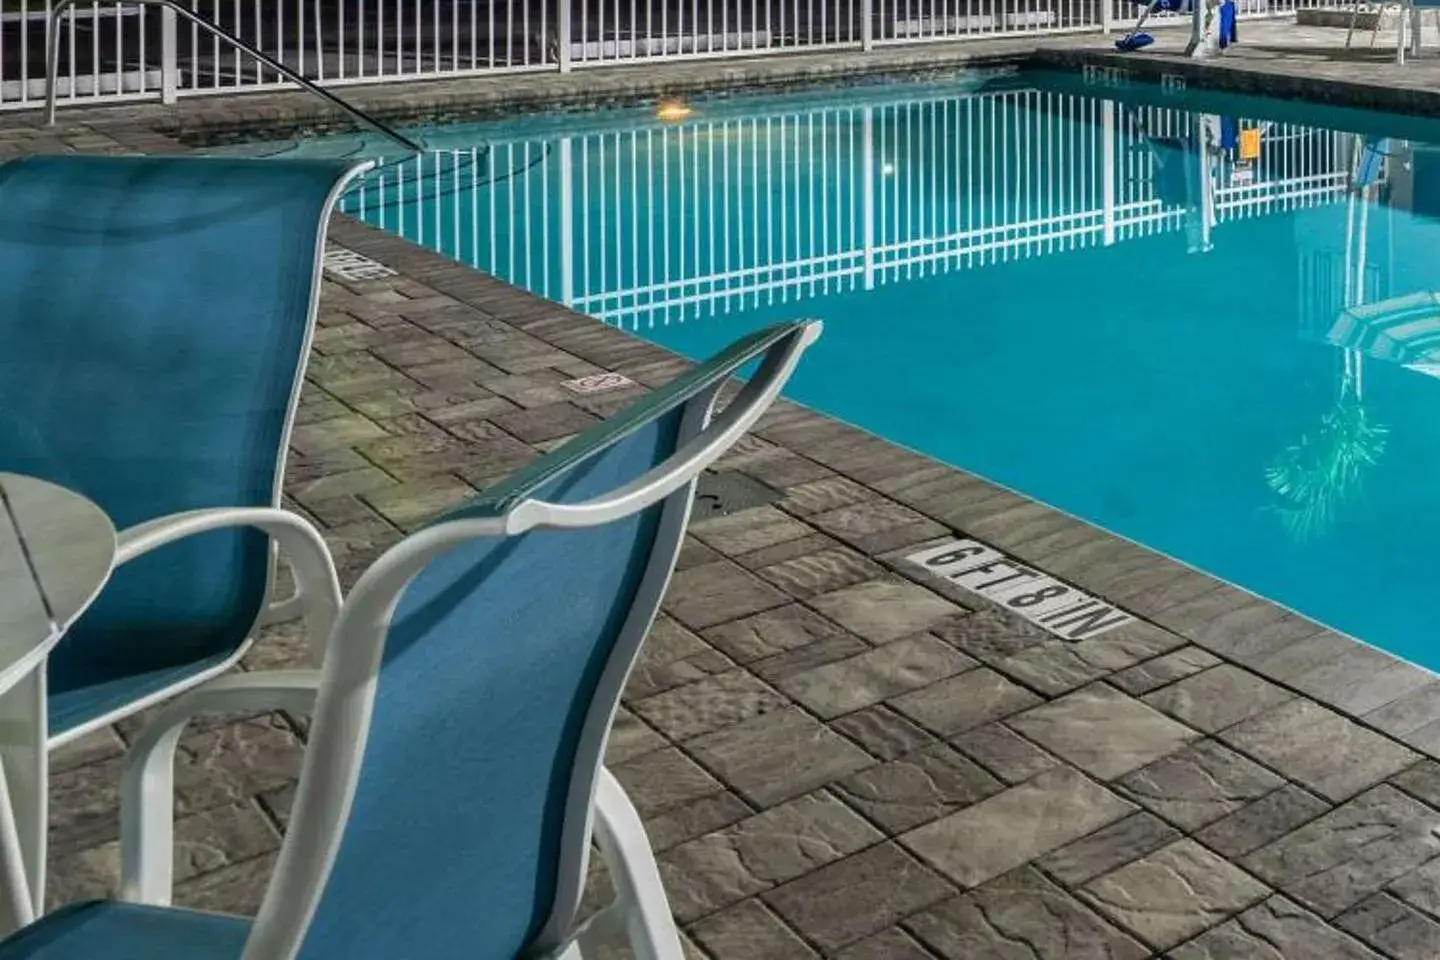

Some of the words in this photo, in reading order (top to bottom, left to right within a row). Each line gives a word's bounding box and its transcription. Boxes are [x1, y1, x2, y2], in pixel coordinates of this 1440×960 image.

[925, 546, 986, 566] 6
[951, 557, 1042, 590] FT
[1006, 585, 1070, 608] 8
[1038, 600, 1132, 638] IN
